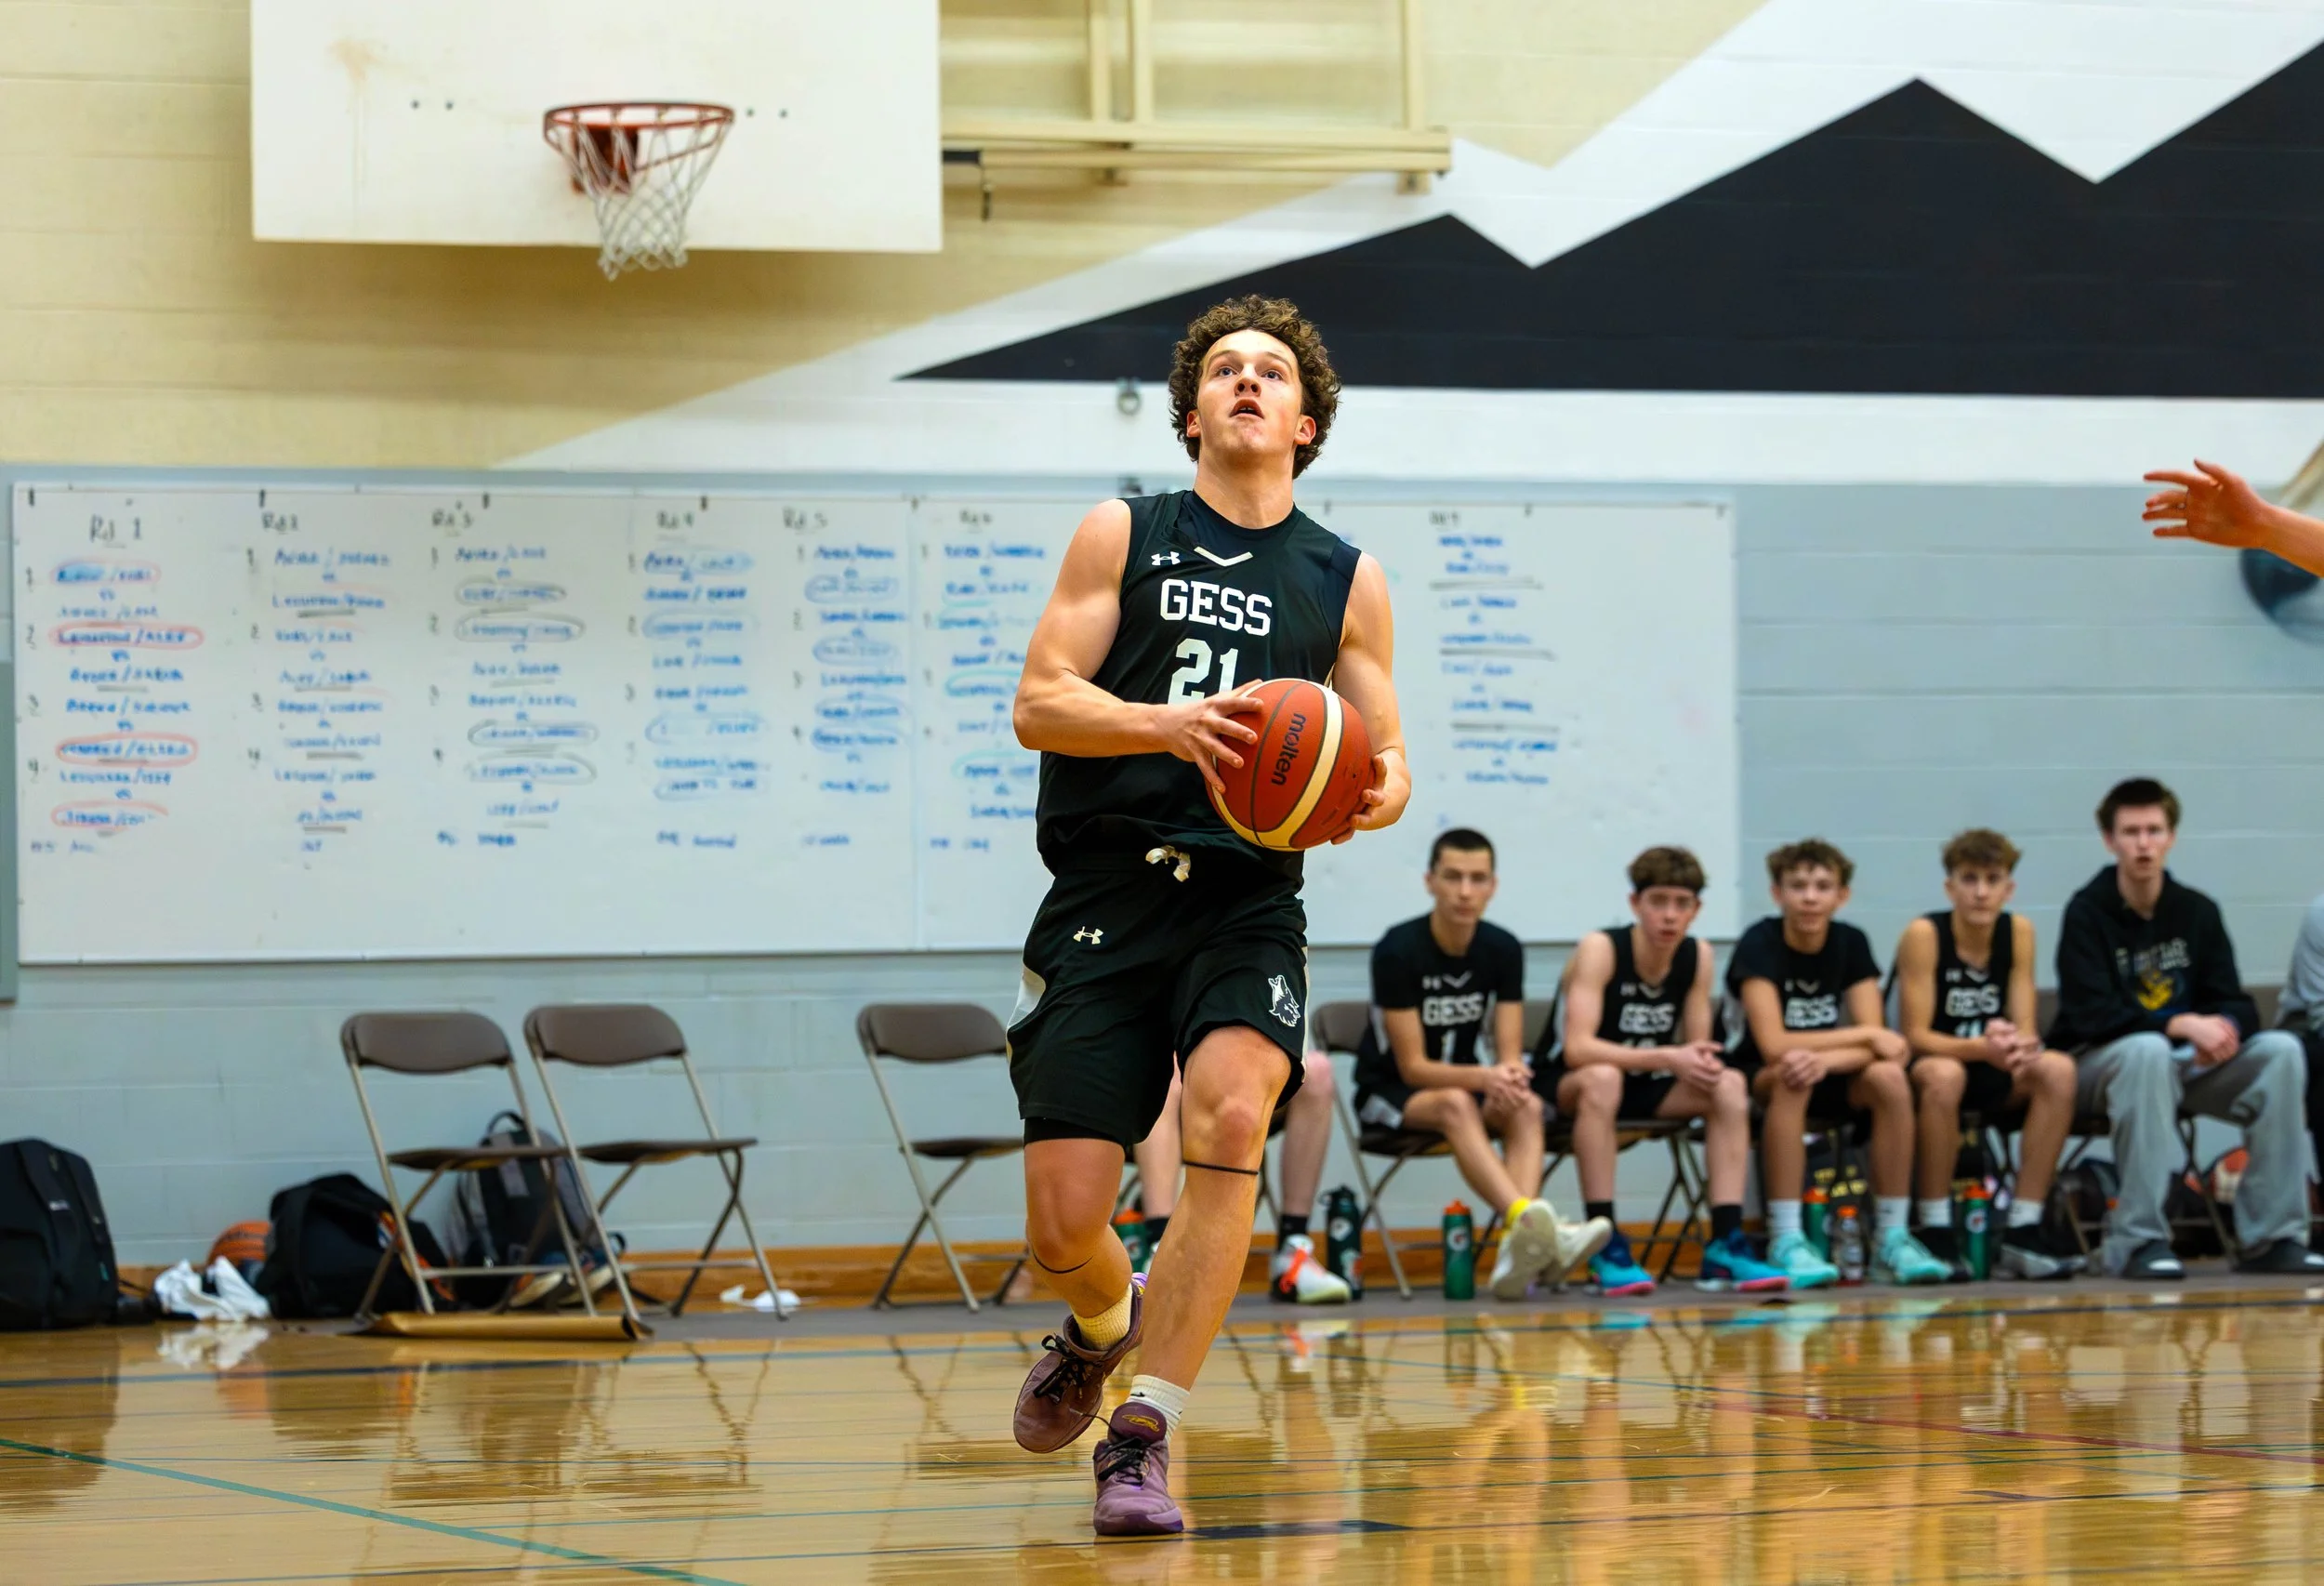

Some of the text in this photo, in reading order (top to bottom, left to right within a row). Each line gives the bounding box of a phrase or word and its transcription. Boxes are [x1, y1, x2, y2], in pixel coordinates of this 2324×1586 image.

[1160, 578, 1273, 637] GESS
[1168, 638, 1239, 705] 21
[1271, 713, 1307, 786] molten
[1422, 992, 1485, 1026] GESS
